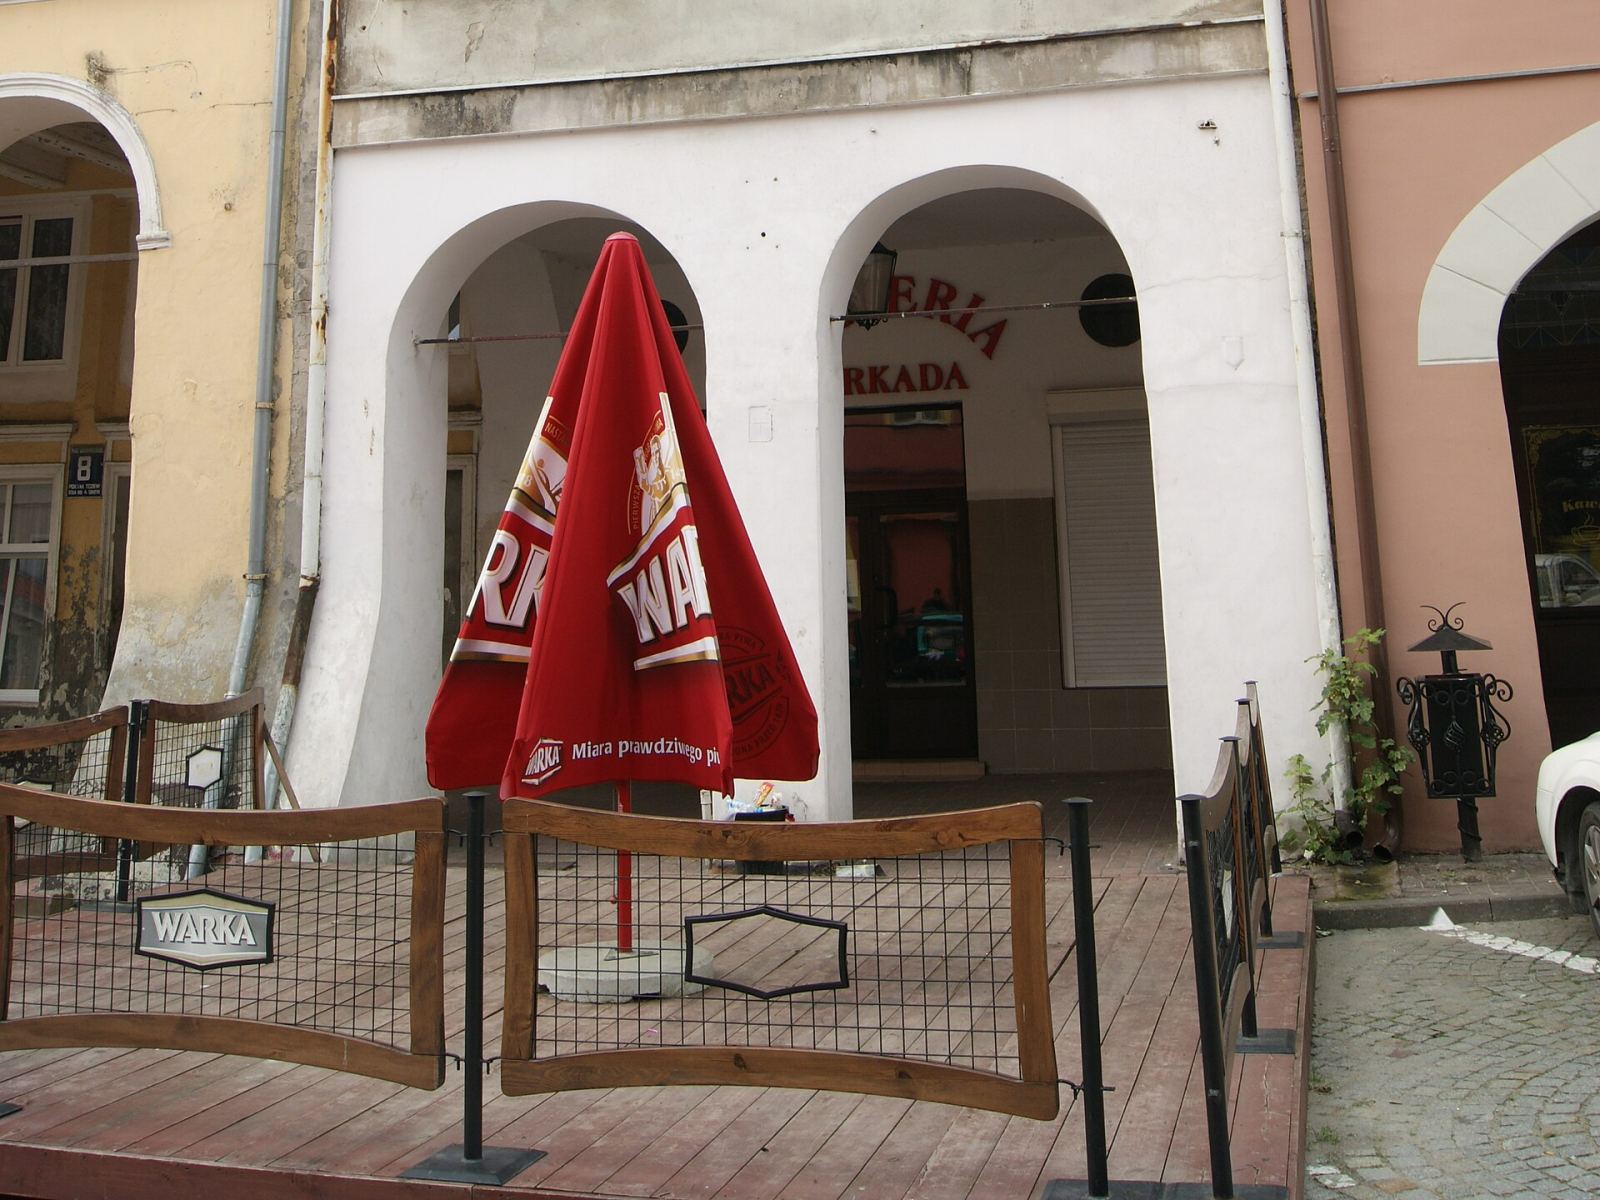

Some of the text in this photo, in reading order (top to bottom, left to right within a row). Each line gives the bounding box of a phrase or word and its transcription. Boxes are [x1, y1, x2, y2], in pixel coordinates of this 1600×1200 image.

[844, 275, 1007, 360] ERIA
[77, 455, 91, 481] 8
[1562, 499, 1600, 513] Kaw
[525, 745, 560, 776] WARKA
[572, 741, 612, 760] Miara
[619, 737, 702, 764] prawdziwego
[151, 911, 257, 946] WARKA
